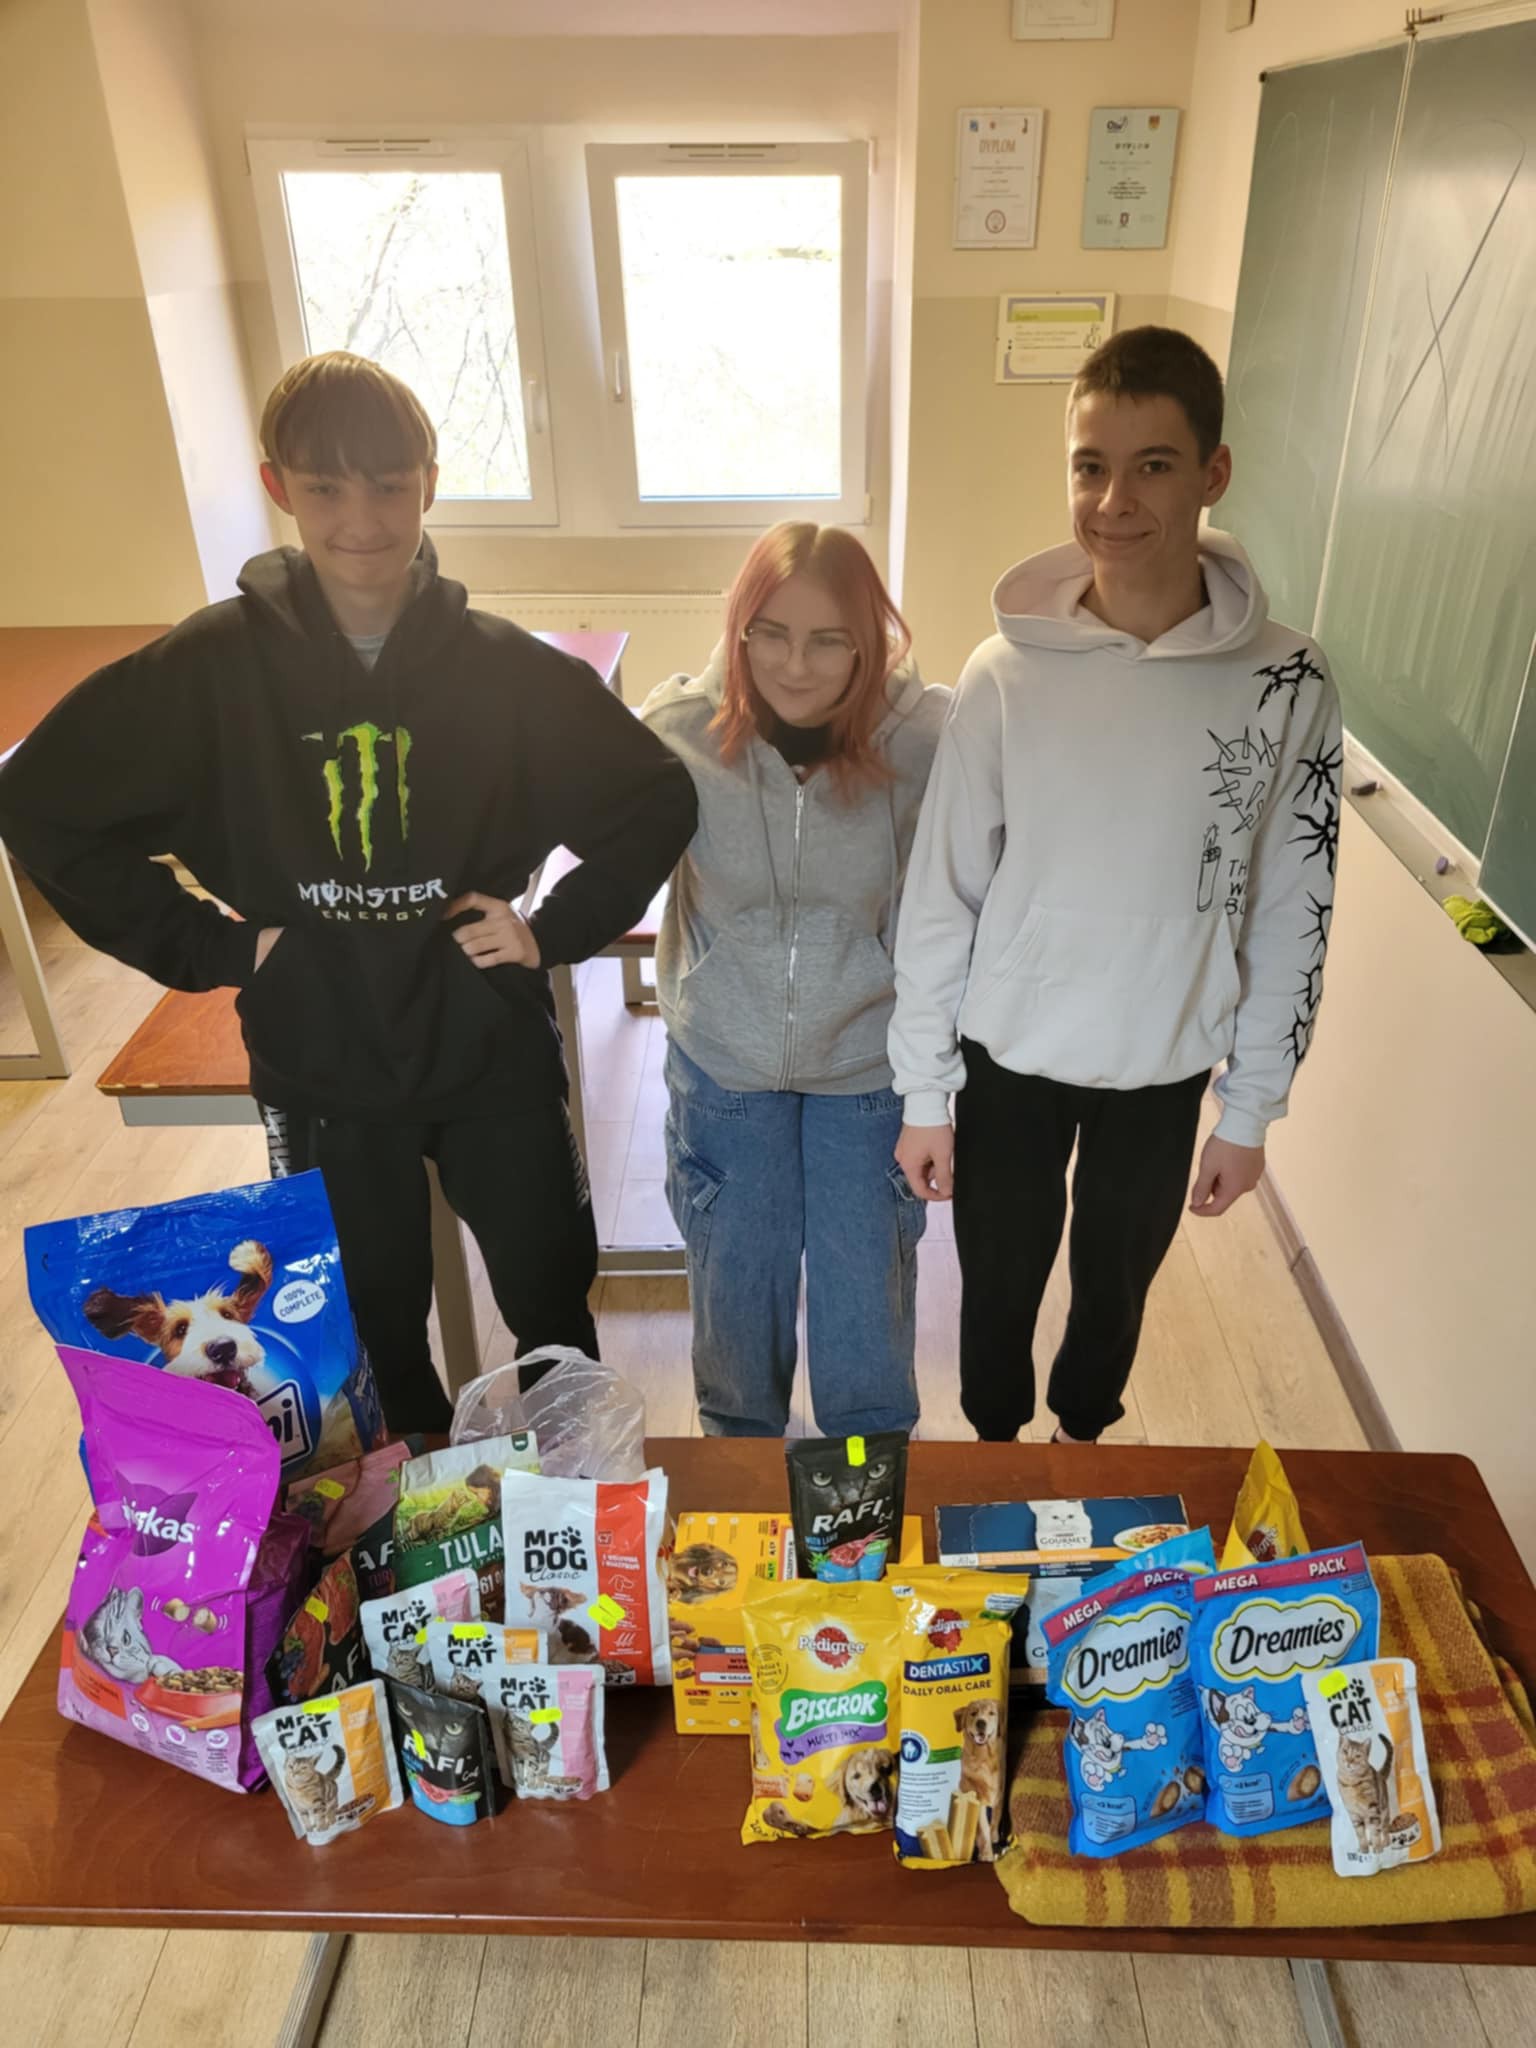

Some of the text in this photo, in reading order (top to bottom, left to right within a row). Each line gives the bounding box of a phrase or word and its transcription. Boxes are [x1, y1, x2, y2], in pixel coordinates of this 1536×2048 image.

[322, 908, 426, 921] ENERGY
[283, 1287, 306, 1301] 100%
[279, 1290, 322, 1318] COMPLETE
[812, 1499, 883, 1534] RAFI
[525, 1529, 559, 1548] Mr
[1040, 1536, 1088, 1546] GOURMET
[524, 1547, 588, 1574] DOG
[1214, 1557, 1346, 1592] MEGA PACK
[1062, 1571, 1184, 1630] MEGA PACK
[381, 1608, 408, 1624] Mr
[383, 1613, 432, 1642] CAT
[914, 1618, 970, 1634] edigree
[798, 1635, 868, 1654] Pedigree
[1230, 1618, 1344, 1664] Dreamies
[448, 1649, 497, 1667] CAT
[1078, 1626, 1183, 1689] Dreamies
[909, 1657, 984, 1678] DENTASTIX
[500, 1677, 527, 1691] Mr
[903, 1680, 992, 1697] DAILY ORAL CARE
[500, 1691, 550, 1710] CAT
[786, 1693, 879, 1731] BISCROK
[1330, 1699, 1372, 1728] CAT
[275, 1714, 305, 1732] Mr
[278, 1720, 332, 1750] CAT
[807, 1730, 838, 1747] MULTI
